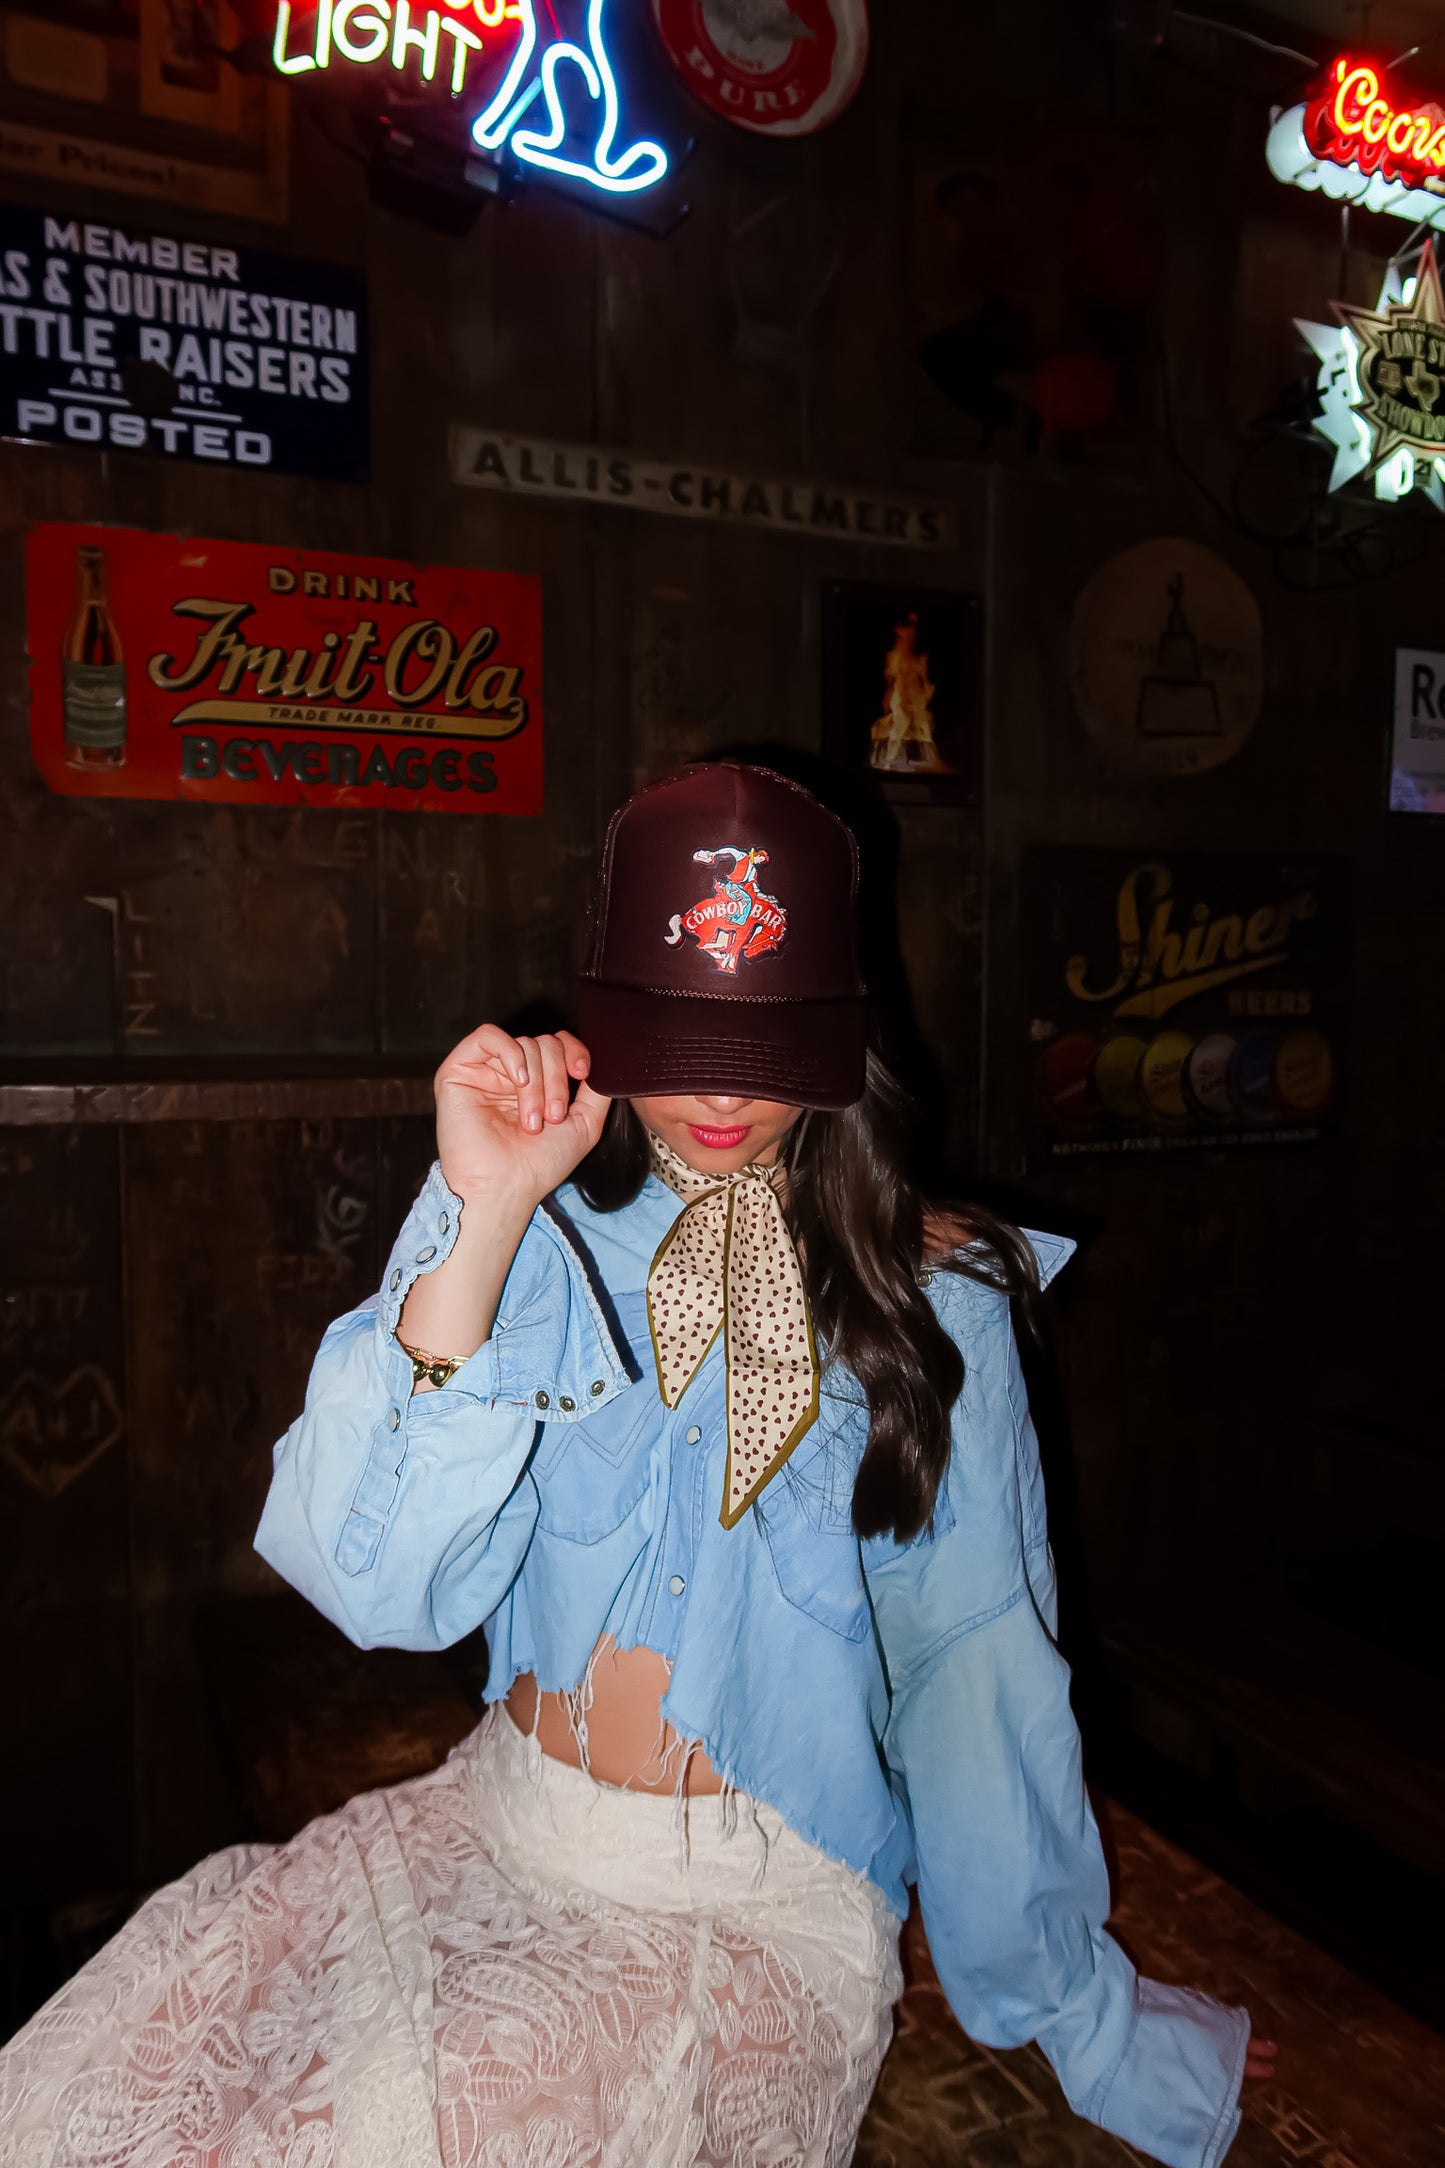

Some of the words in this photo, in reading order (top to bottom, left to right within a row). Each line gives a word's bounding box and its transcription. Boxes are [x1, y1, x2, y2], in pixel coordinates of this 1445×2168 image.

[273, 0, 483, 93] LIGHT
[43, 215, 241, 282] MEMBER
[42, 256, 73, 307] &
[83, 263, 357, 354] SOUTHWESTERN
[0, 303, 118, 370] TTLE
[139, 325, 352, 405] RAISERS
[177, 383, 223, 407] NC.
[16, 398, 272, 466] POSTED
[473, 440, 941, 543] ALLIS-CHALMERS
[268, 566, 416, 607] DRINK
[148, 597, 528, 715] Fruit-Ola
[269, 706, 330, 722] TRADE
[336, 711, 392, 726] MARK
[180, 734, 498, 793] BEVERAGES
[686, 900, 748, 930] COWBOY
[750, 903, 783, 931] BAR
[1065, 861, 1319, 1004] Shiner
[1226, 989, 1313, 1017] BEERS
